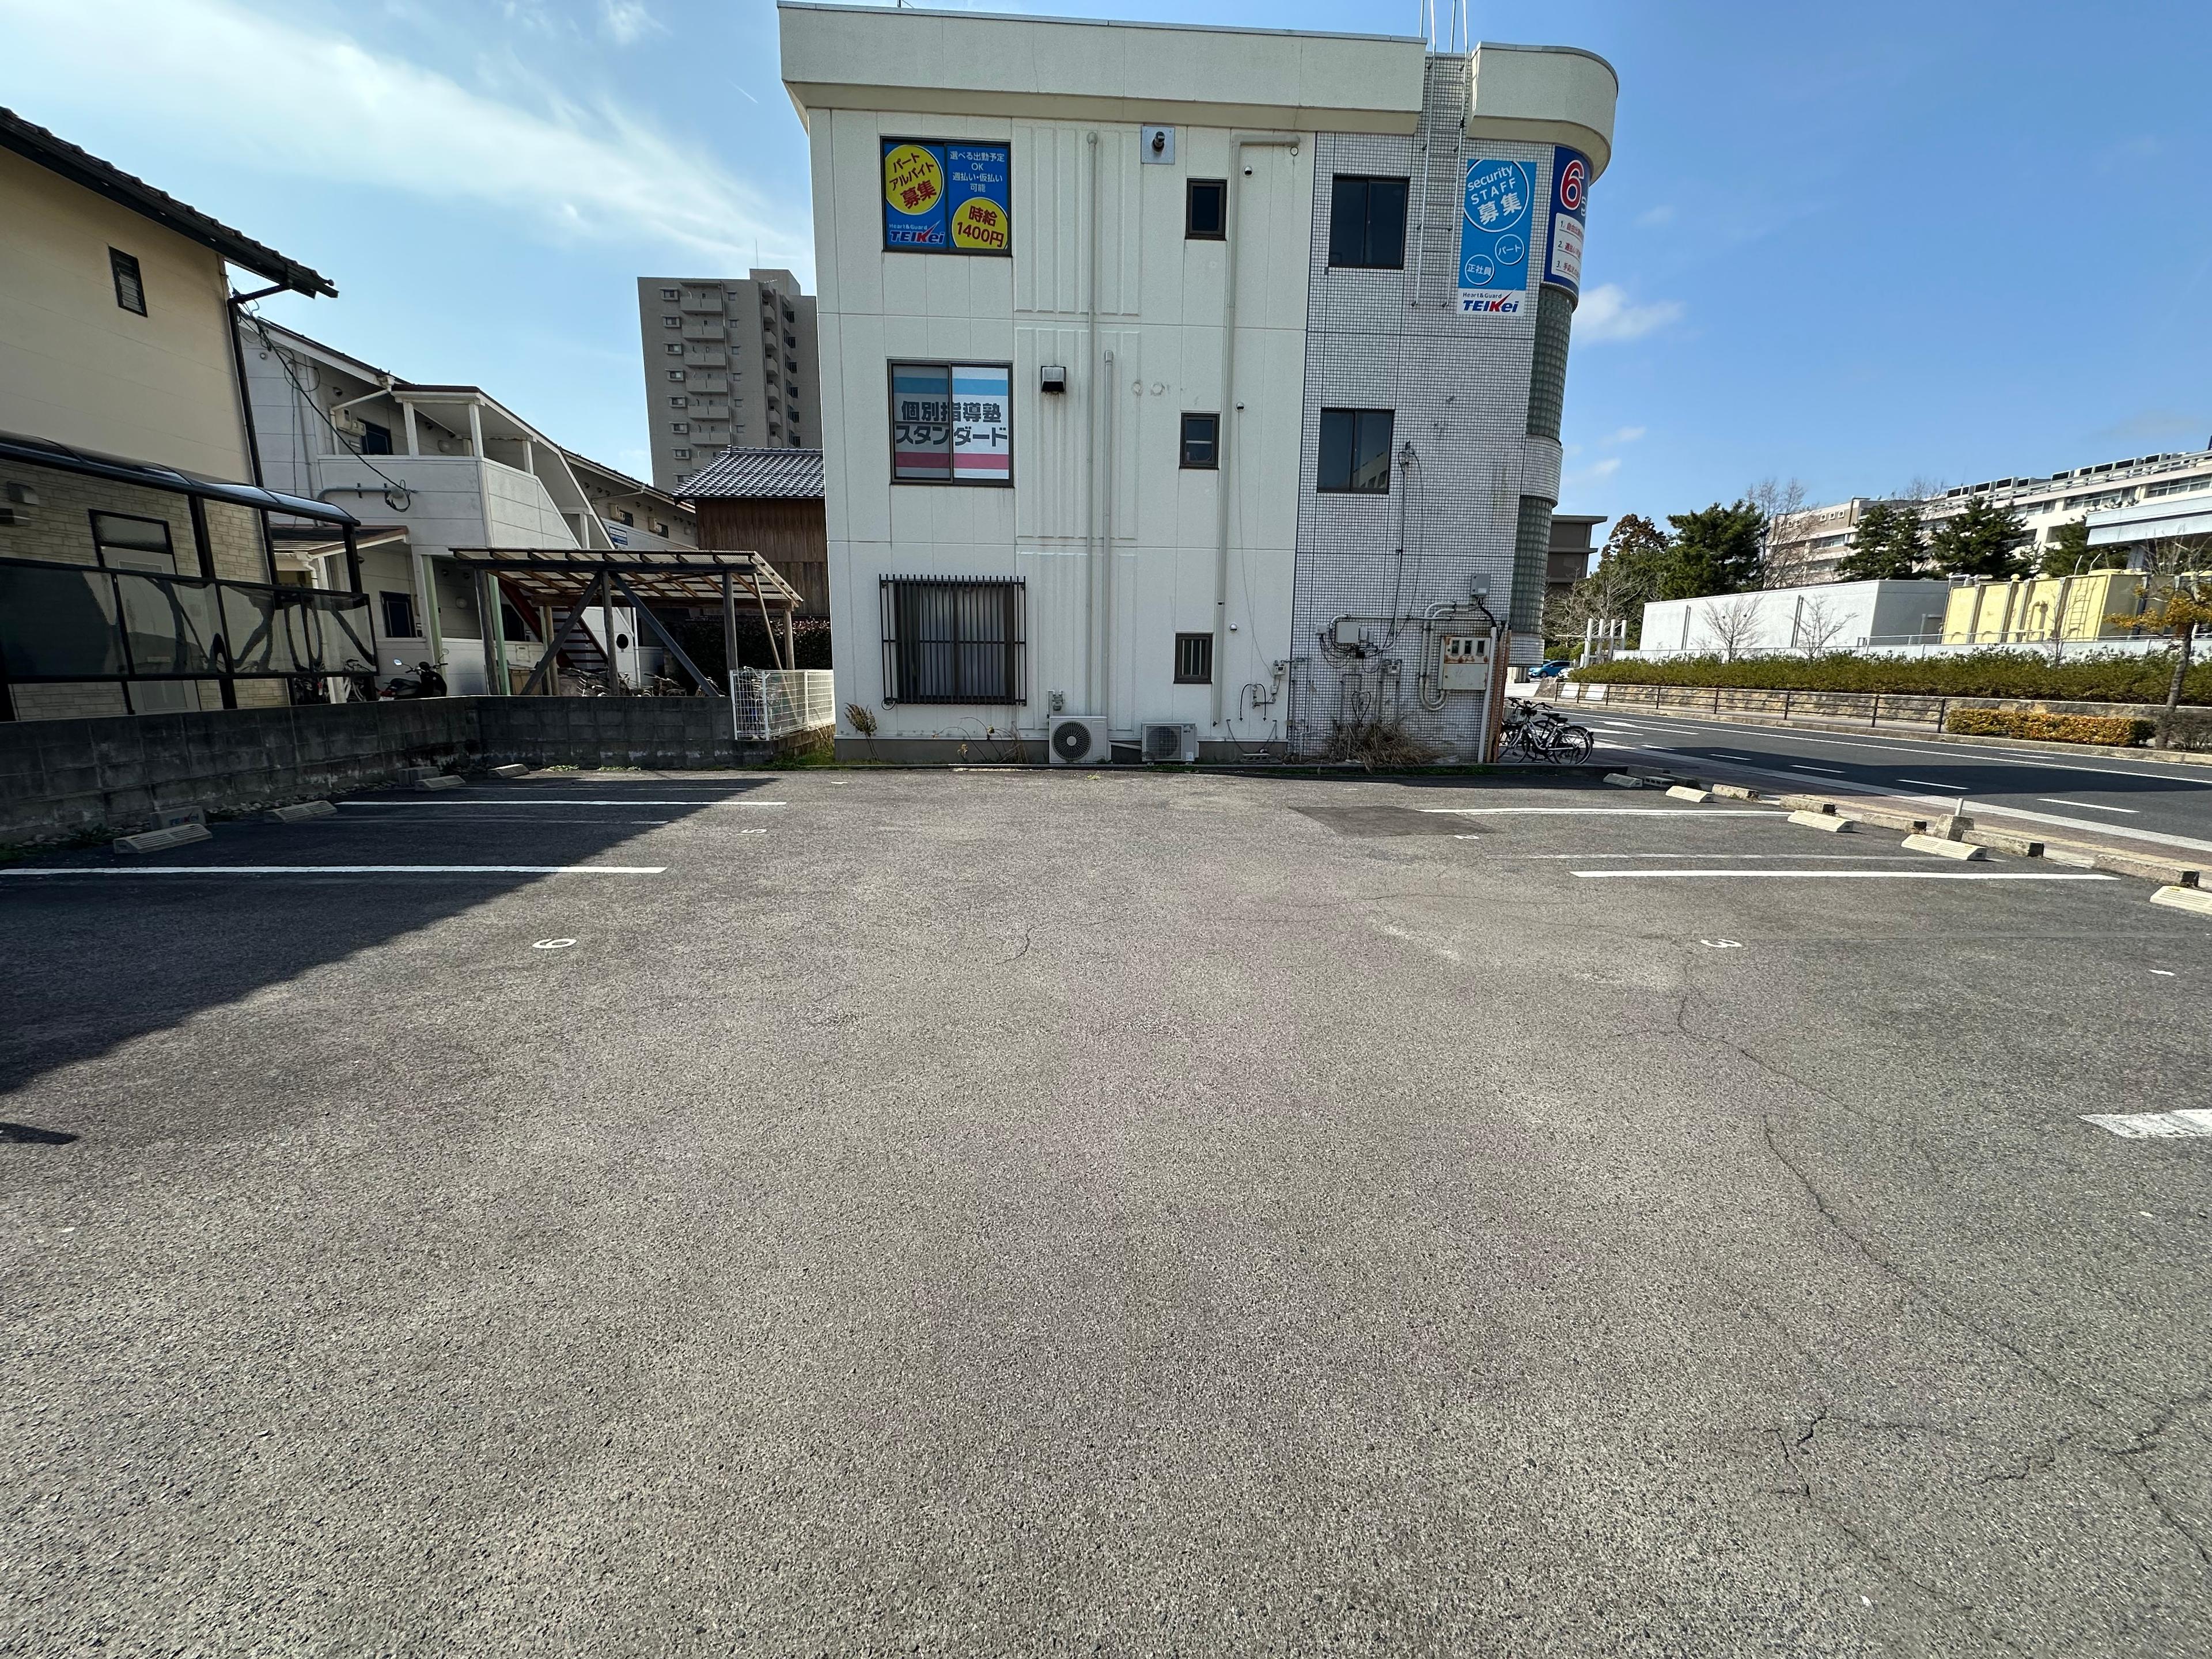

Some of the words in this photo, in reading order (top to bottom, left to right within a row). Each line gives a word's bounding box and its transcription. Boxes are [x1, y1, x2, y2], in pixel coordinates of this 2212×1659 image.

[893, 152, 920, 173] パート
[949, 151, 1005, 162] 選べる出勤予定
[971, 162, 984, 171] OK
[889, 162, 935, 191] アルバイト
[969, 183, 986, 192] 可能
[1467, 165, 1513, 191] security
[1560, 160, 1584, 210] 6
[900, 179, 937, 210] 募集
[1471, 177, 1517, 204] STAFF
[968, 205, 998, 227] 時給
[1477, 192, 1522, 225] 募集
[956, 221, 1005, 248] 1400円
[1498, 244, 1521, 256] パート
[1467, 263, 1492, 276] 正社員
[901, 400, 1002, 423] 個別指導塾
[896, 425, 1008, 447] スタンダード
